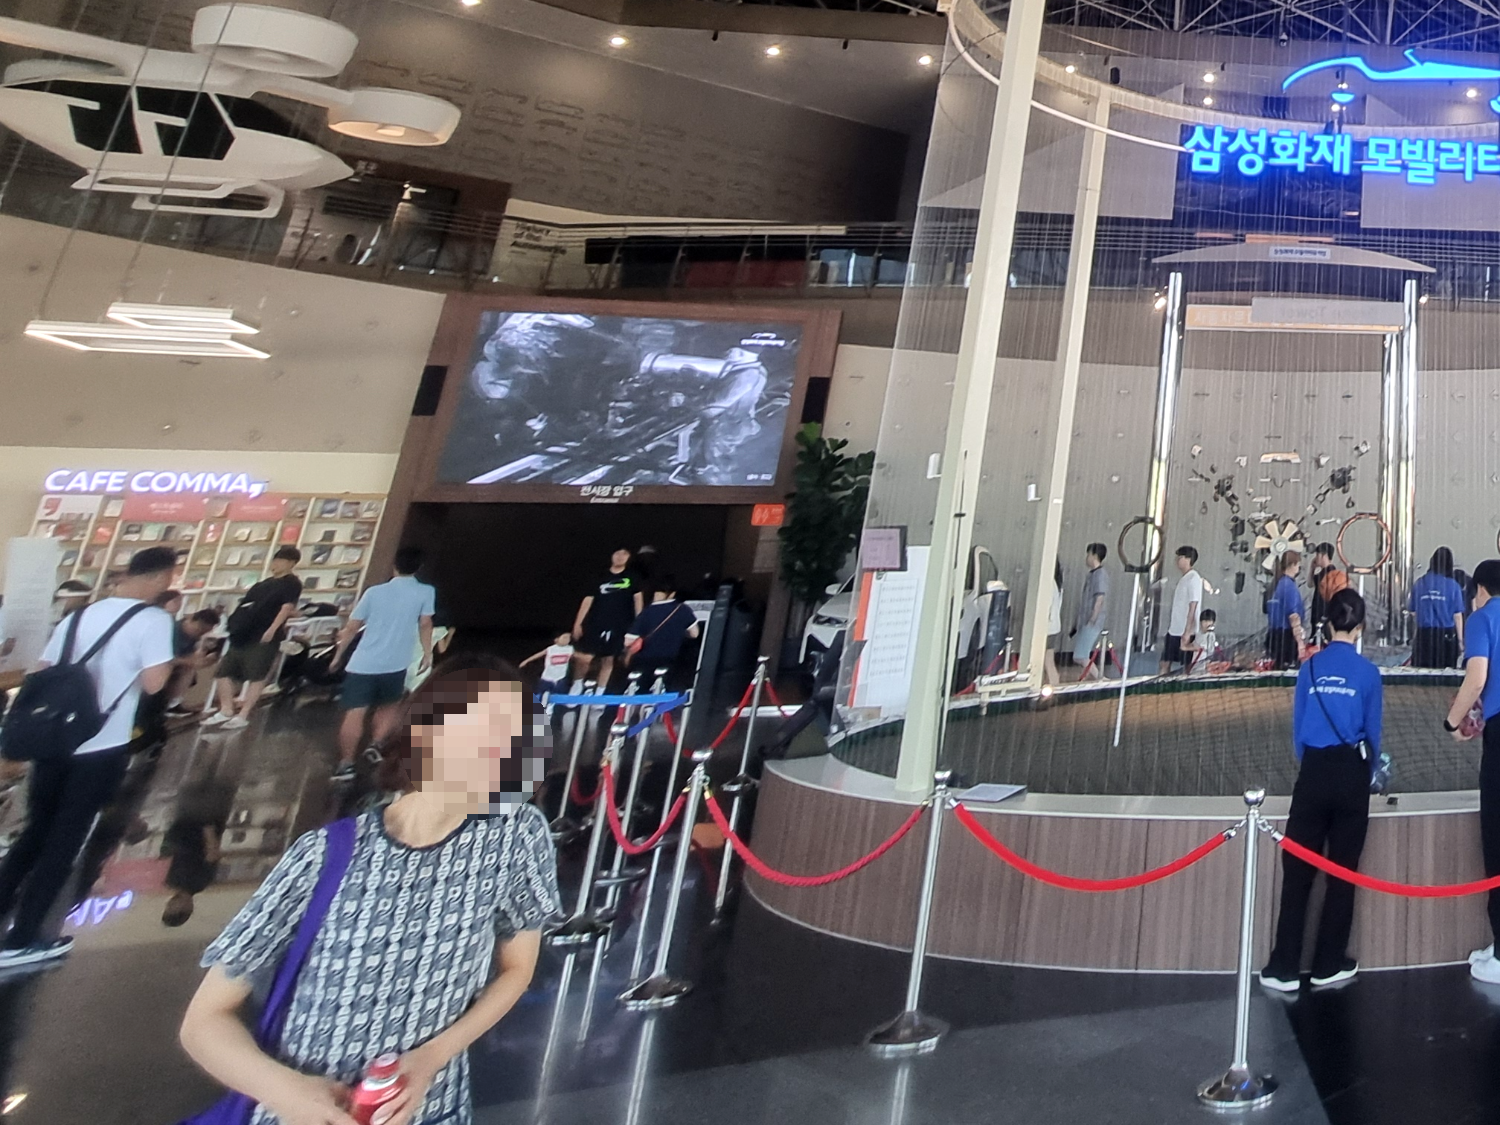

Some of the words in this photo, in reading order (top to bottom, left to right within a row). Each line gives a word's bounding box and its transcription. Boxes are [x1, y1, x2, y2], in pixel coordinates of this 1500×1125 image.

[1184, 125, 1353, 176] 삼성화재
[44, 469, 129, 493] CAFE
[580, 484, 612, 497] 전시장
[613, 485, 634, 497] 입구
